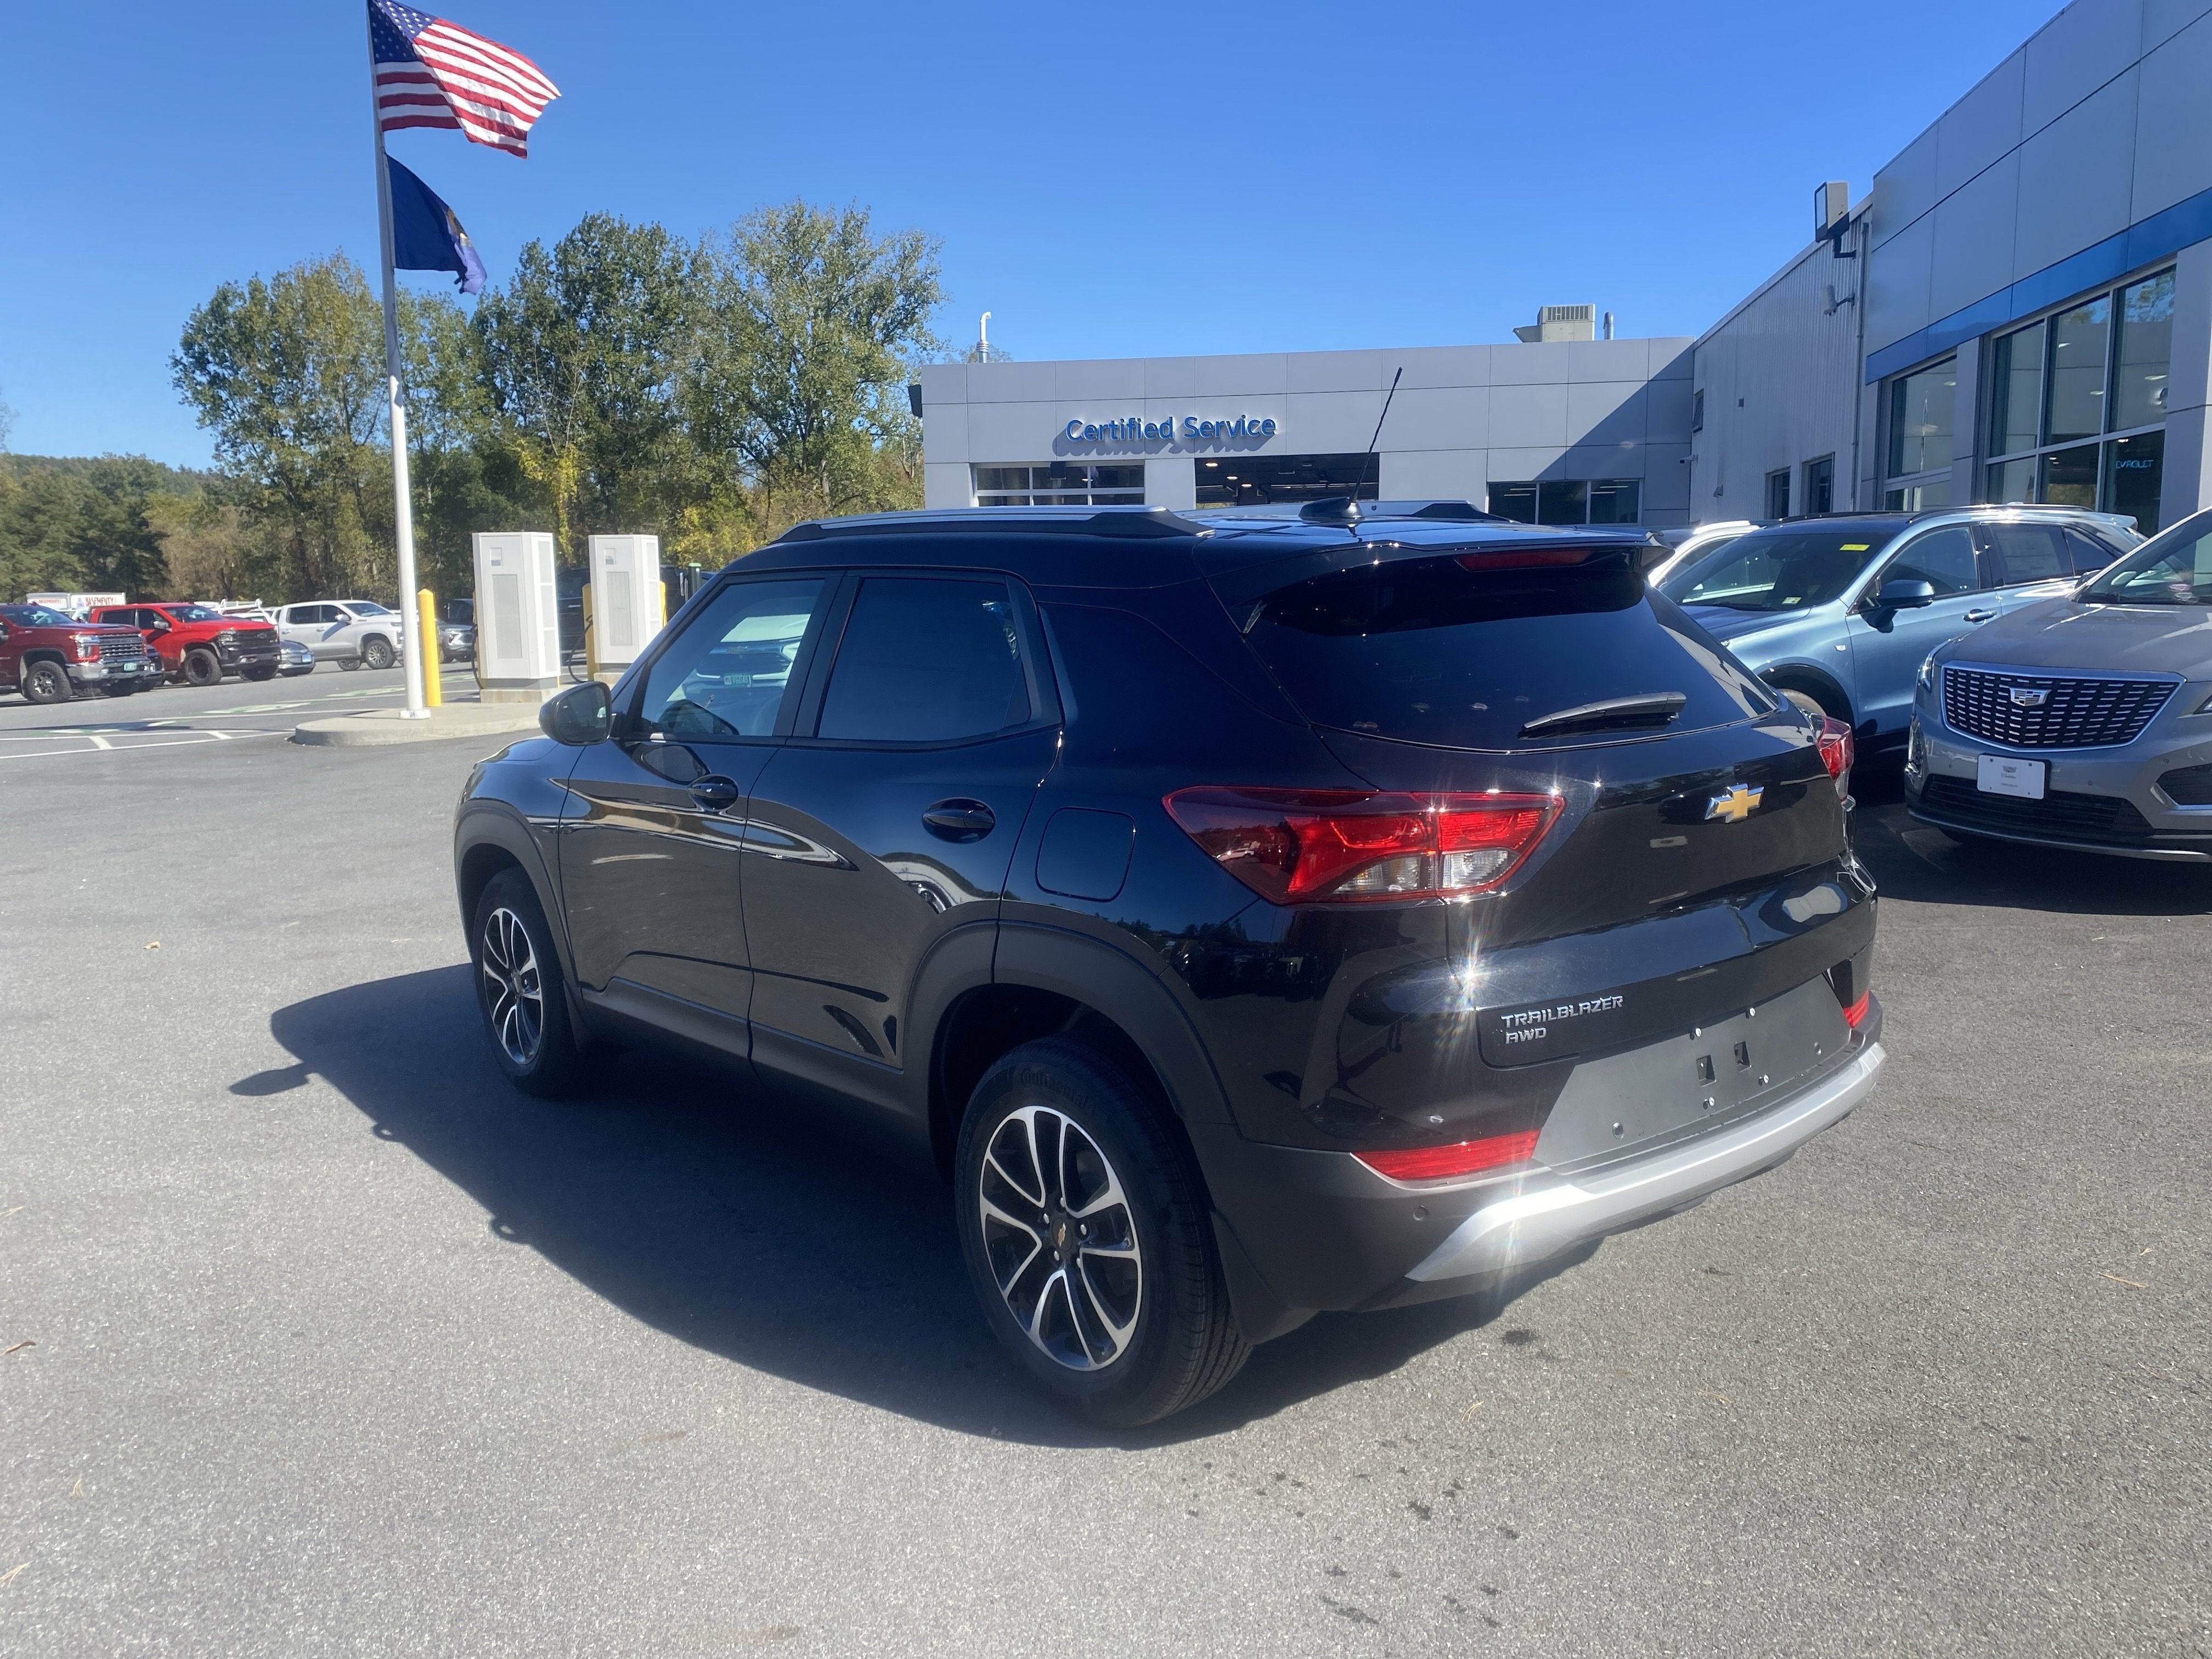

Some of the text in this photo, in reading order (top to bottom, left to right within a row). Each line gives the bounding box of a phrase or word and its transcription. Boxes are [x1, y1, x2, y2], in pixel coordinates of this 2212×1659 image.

[1066, 414, 1276, 442] Certified Service
[2115, 459, 2154, 469] EVROLET
[1501, 995, 1623, 1028] TRAILBLAZER
[1506, 1028, 1547, 1044] AWD
